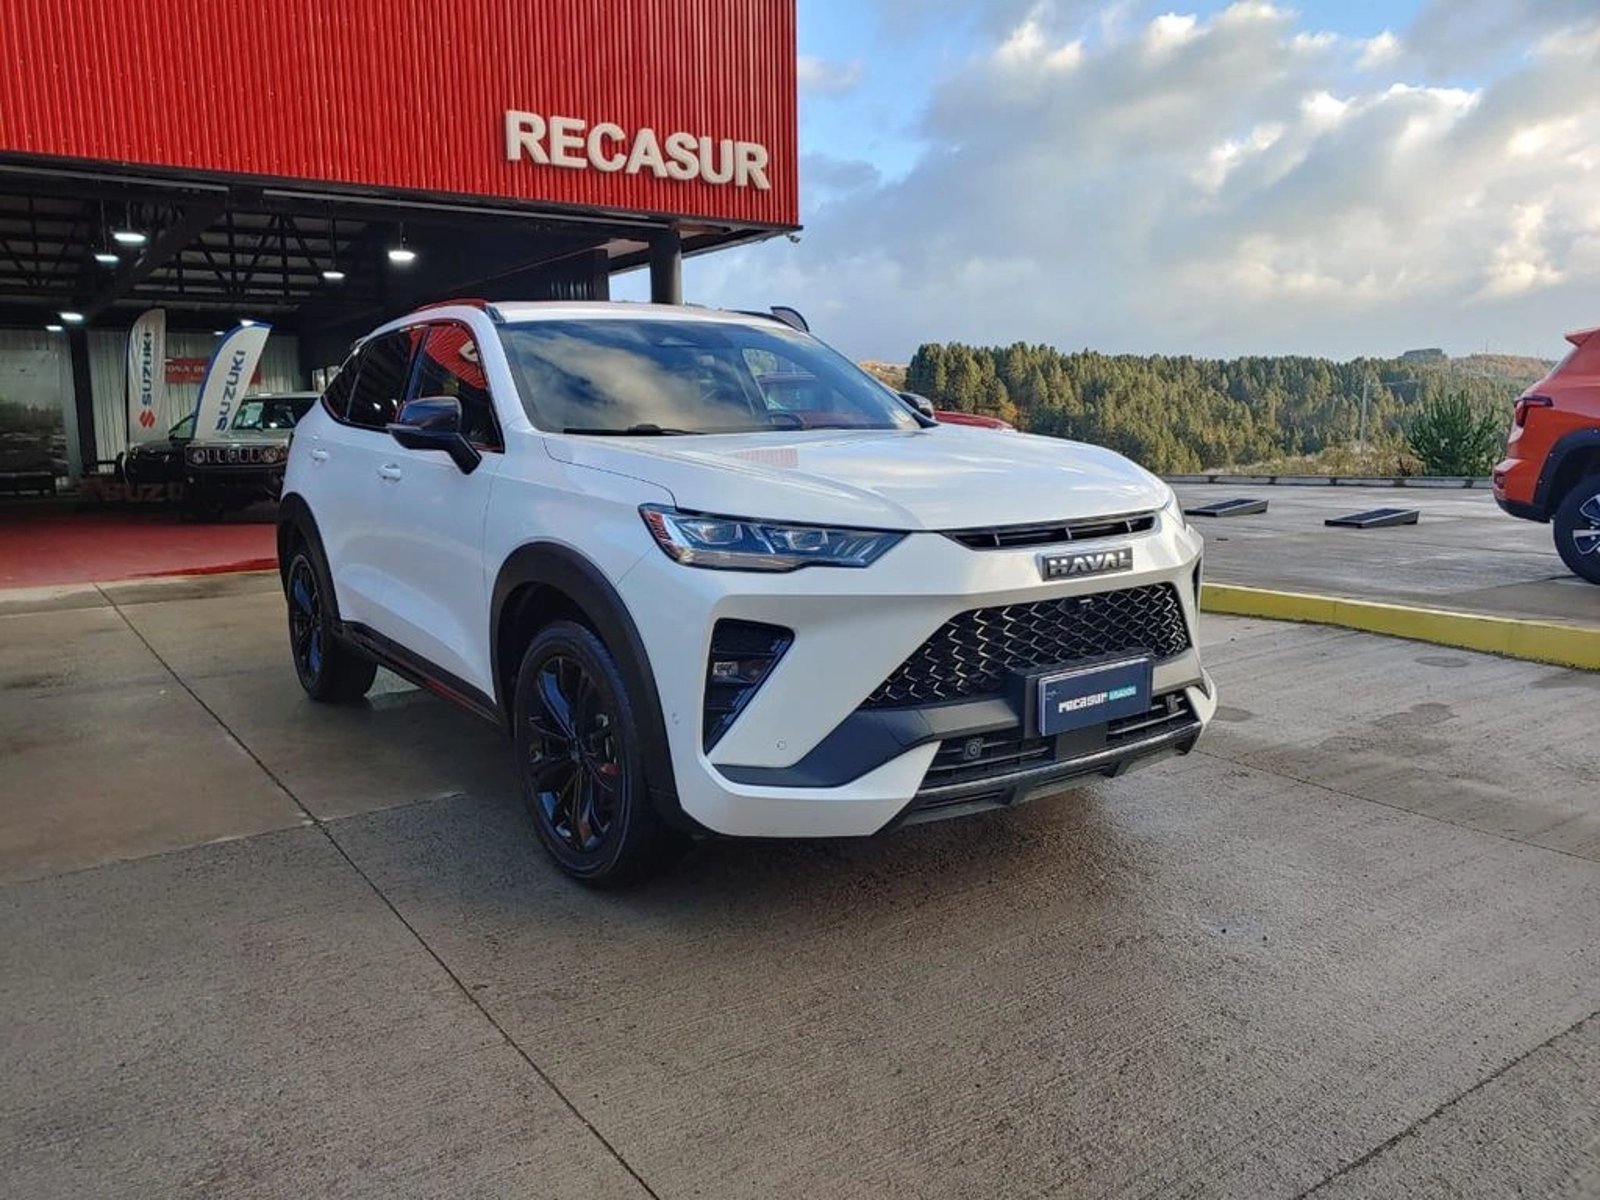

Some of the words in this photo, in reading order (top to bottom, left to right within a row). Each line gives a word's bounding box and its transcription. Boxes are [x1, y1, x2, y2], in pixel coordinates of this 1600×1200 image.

[505, 109, 770, 190] RECASUR
[142, 332, 152, 407] SUZUKI
[215, 349, 246, 432] SUZUKI
[1049, 551, 1132, 576] HAVAL
